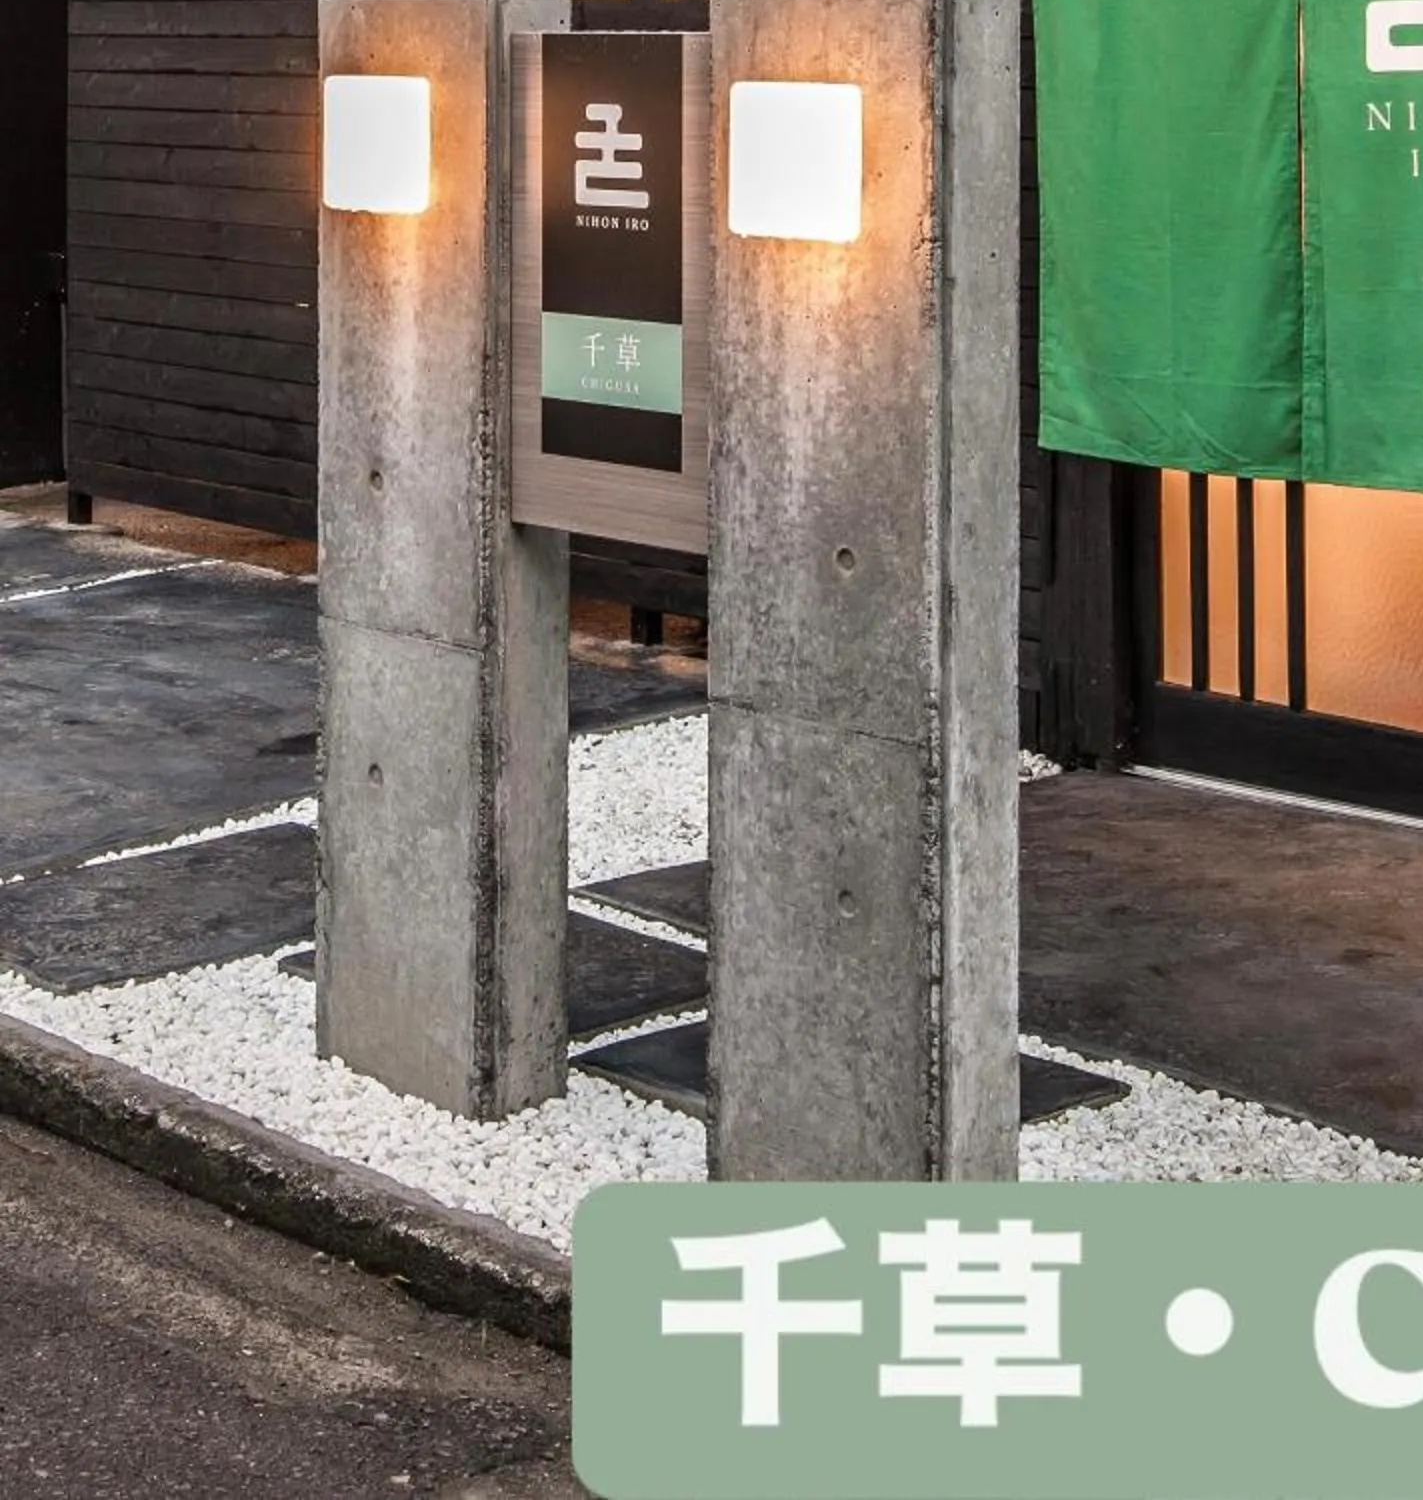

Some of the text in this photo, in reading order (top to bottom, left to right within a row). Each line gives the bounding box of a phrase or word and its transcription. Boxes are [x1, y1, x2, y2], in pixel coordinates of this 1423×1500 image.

[575, 214, 649, 231] NIHON IRO
[581, 331, 641, 372] 千草
